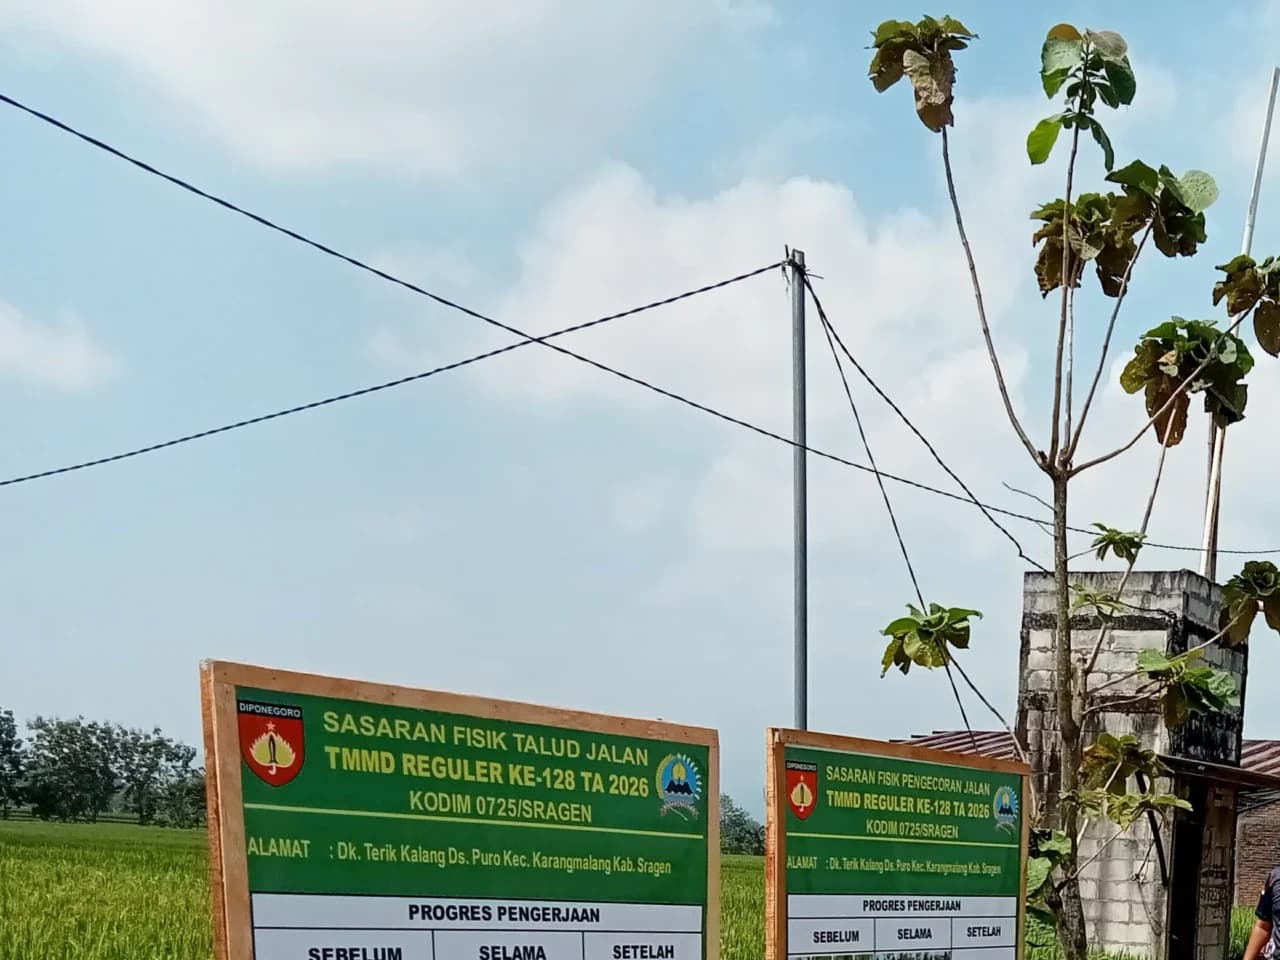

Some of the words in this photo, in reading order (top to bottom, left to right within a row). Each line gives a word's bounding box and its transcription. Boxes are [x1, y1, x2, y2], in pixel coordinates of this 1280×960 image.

[239, 702, 301, 718] DIPONEGORO
[323, 711, 446, 744] SASARAN
[453, 726, 508, 751] FISIK
[513, 733, 580, 758] TALUD
[586, 742, 648, 766] JALAN
[324, 746, 396, 774] TMMD
[402, 752, 504, 785] REGULER
[508, 763, 576, 791] KE-128
[580, 771, 604, 794] TA
[609, 774, 649, 797] 2026
[826, 765, 876, 784] SASARAN
[878, 771, 900, 787] FISIK
[902, 773, 961, 793] PENGECORAN
[963, 781, 990, 796] JALAN
[409, 790, 472, 814] KODIM
[476, 796, 592, 823] 0725/SRAGEN
[826, 790, 861, 809] TMMD
[864, 793, 914, 813] REGULER
[917, 797, 951, 816] KE-128
[953, 801, 966, 817] TA
[968, 803, 990, 819] 2026
[866, 819, 898, 835] KODIM
[900, 821, 959, 839] 0725/SRAGEN
[247, 837, 311, 858] ALAMAT
[337, 842, 361, 861] Dk.
[364, 843, 397, 862] Terik
[400, 845, 446, 868] Kalang
[448, 847, 469, 865] Ds.
[472, 848, 501, 866] Puro
[503, 850, 530, 868] Kec.
[532, 851, 611, 875] Karangmalang
[613, 856, 636, 873] Kab.
[637, 857, 672, 877] Sragen
[786, 855, 818, 870] ALAMAT
[842, 857, 859, 870] Terik
[860, 858, 884, 874] Kalang
[896, 859, 911, 872] Puro
[926, 860, 968, 876] Karangmalang
[981, 862, 1002, 877] Sragen
[408, 904, 492, 922] PROGRES
[497, 906, 601, 922] PENGERJAAN
[863, 900, 905, 912] PROGRES
[908, 900, 961, 911] PENGERJAAN
[813, 930, 860, 943] SEBELUM
[897, 928, 932, 940] SELAMA
[967, 926, 1001, 937] SETELAH
[479, 945, 547, 960] SELAMA
[613, 945, 675, 960] SETELAH
